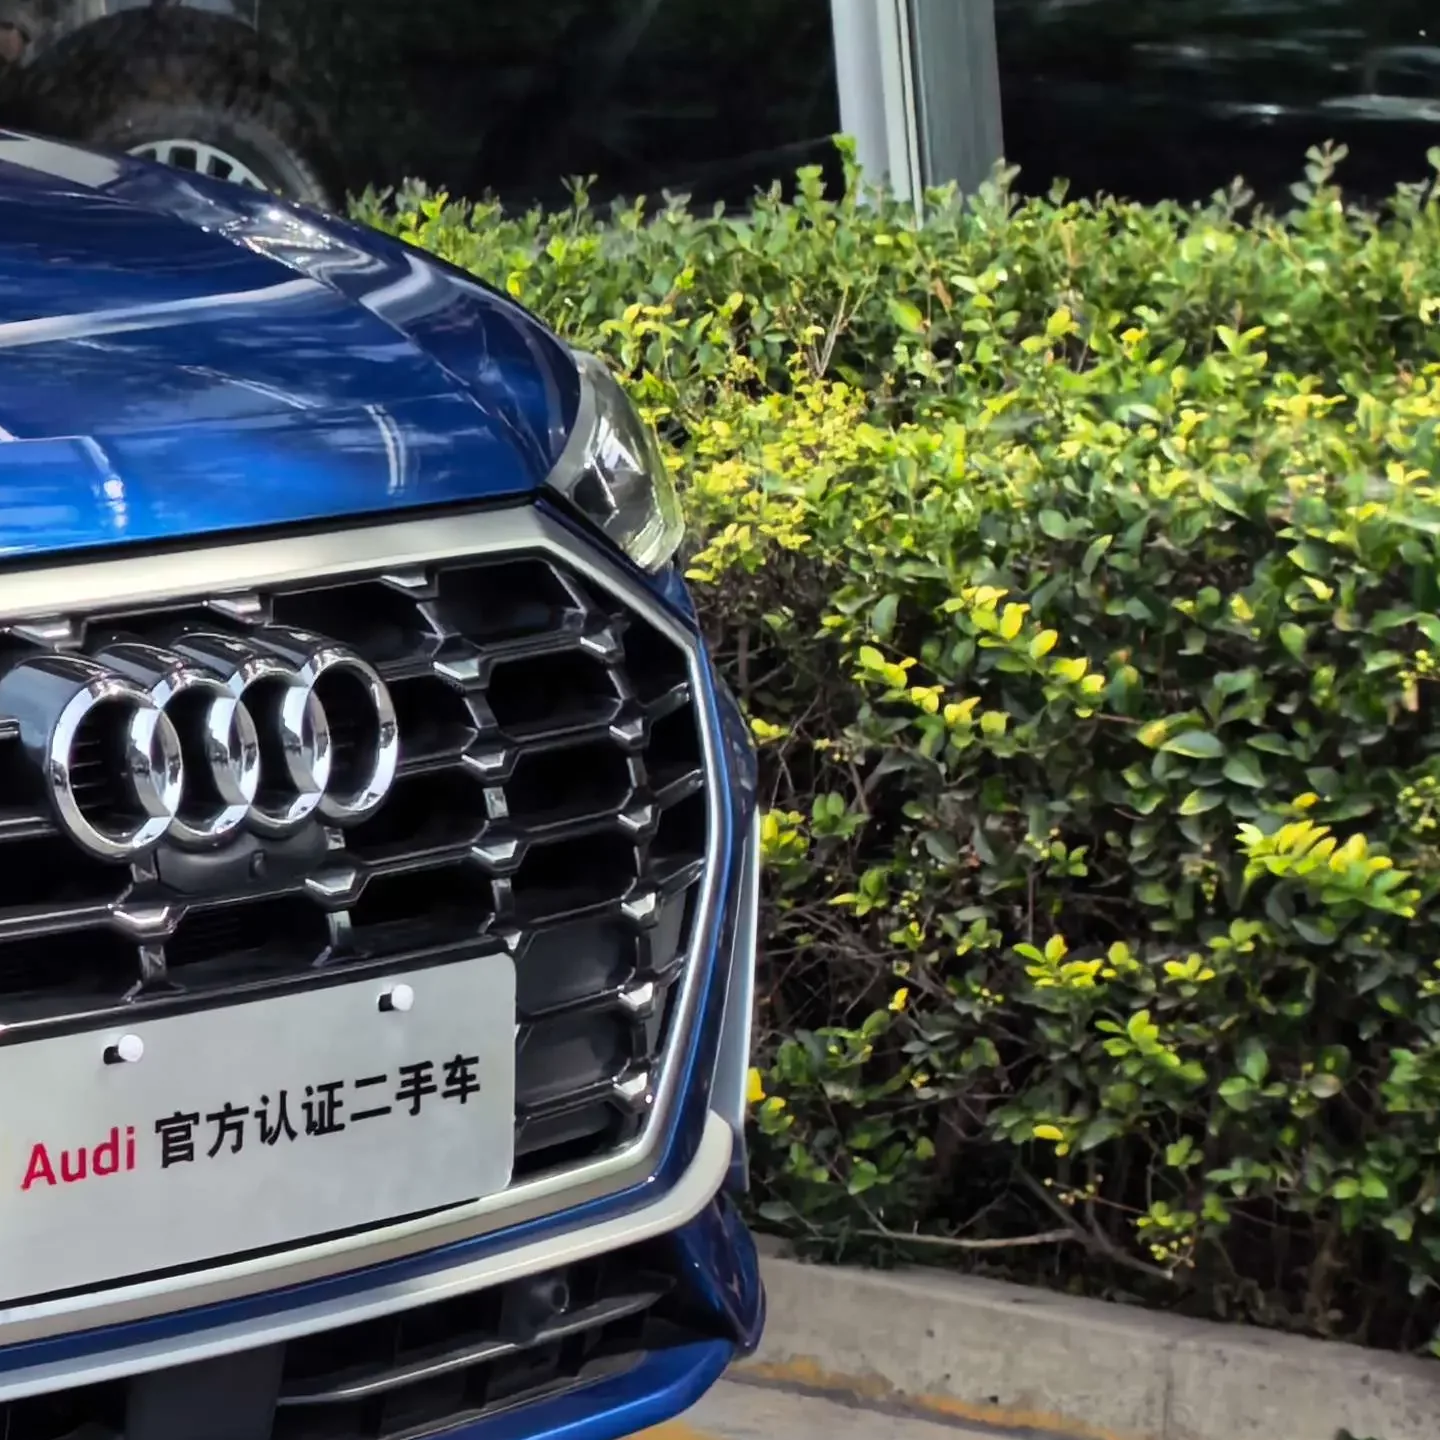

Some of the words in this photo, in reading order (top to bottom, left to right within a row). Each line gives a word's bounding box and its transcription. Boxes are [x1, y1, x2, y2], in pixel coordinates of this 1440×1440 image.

[20, 1125, 136, 1190] Audi
[154, 1054, 481, 1169] 官方认证二手车
